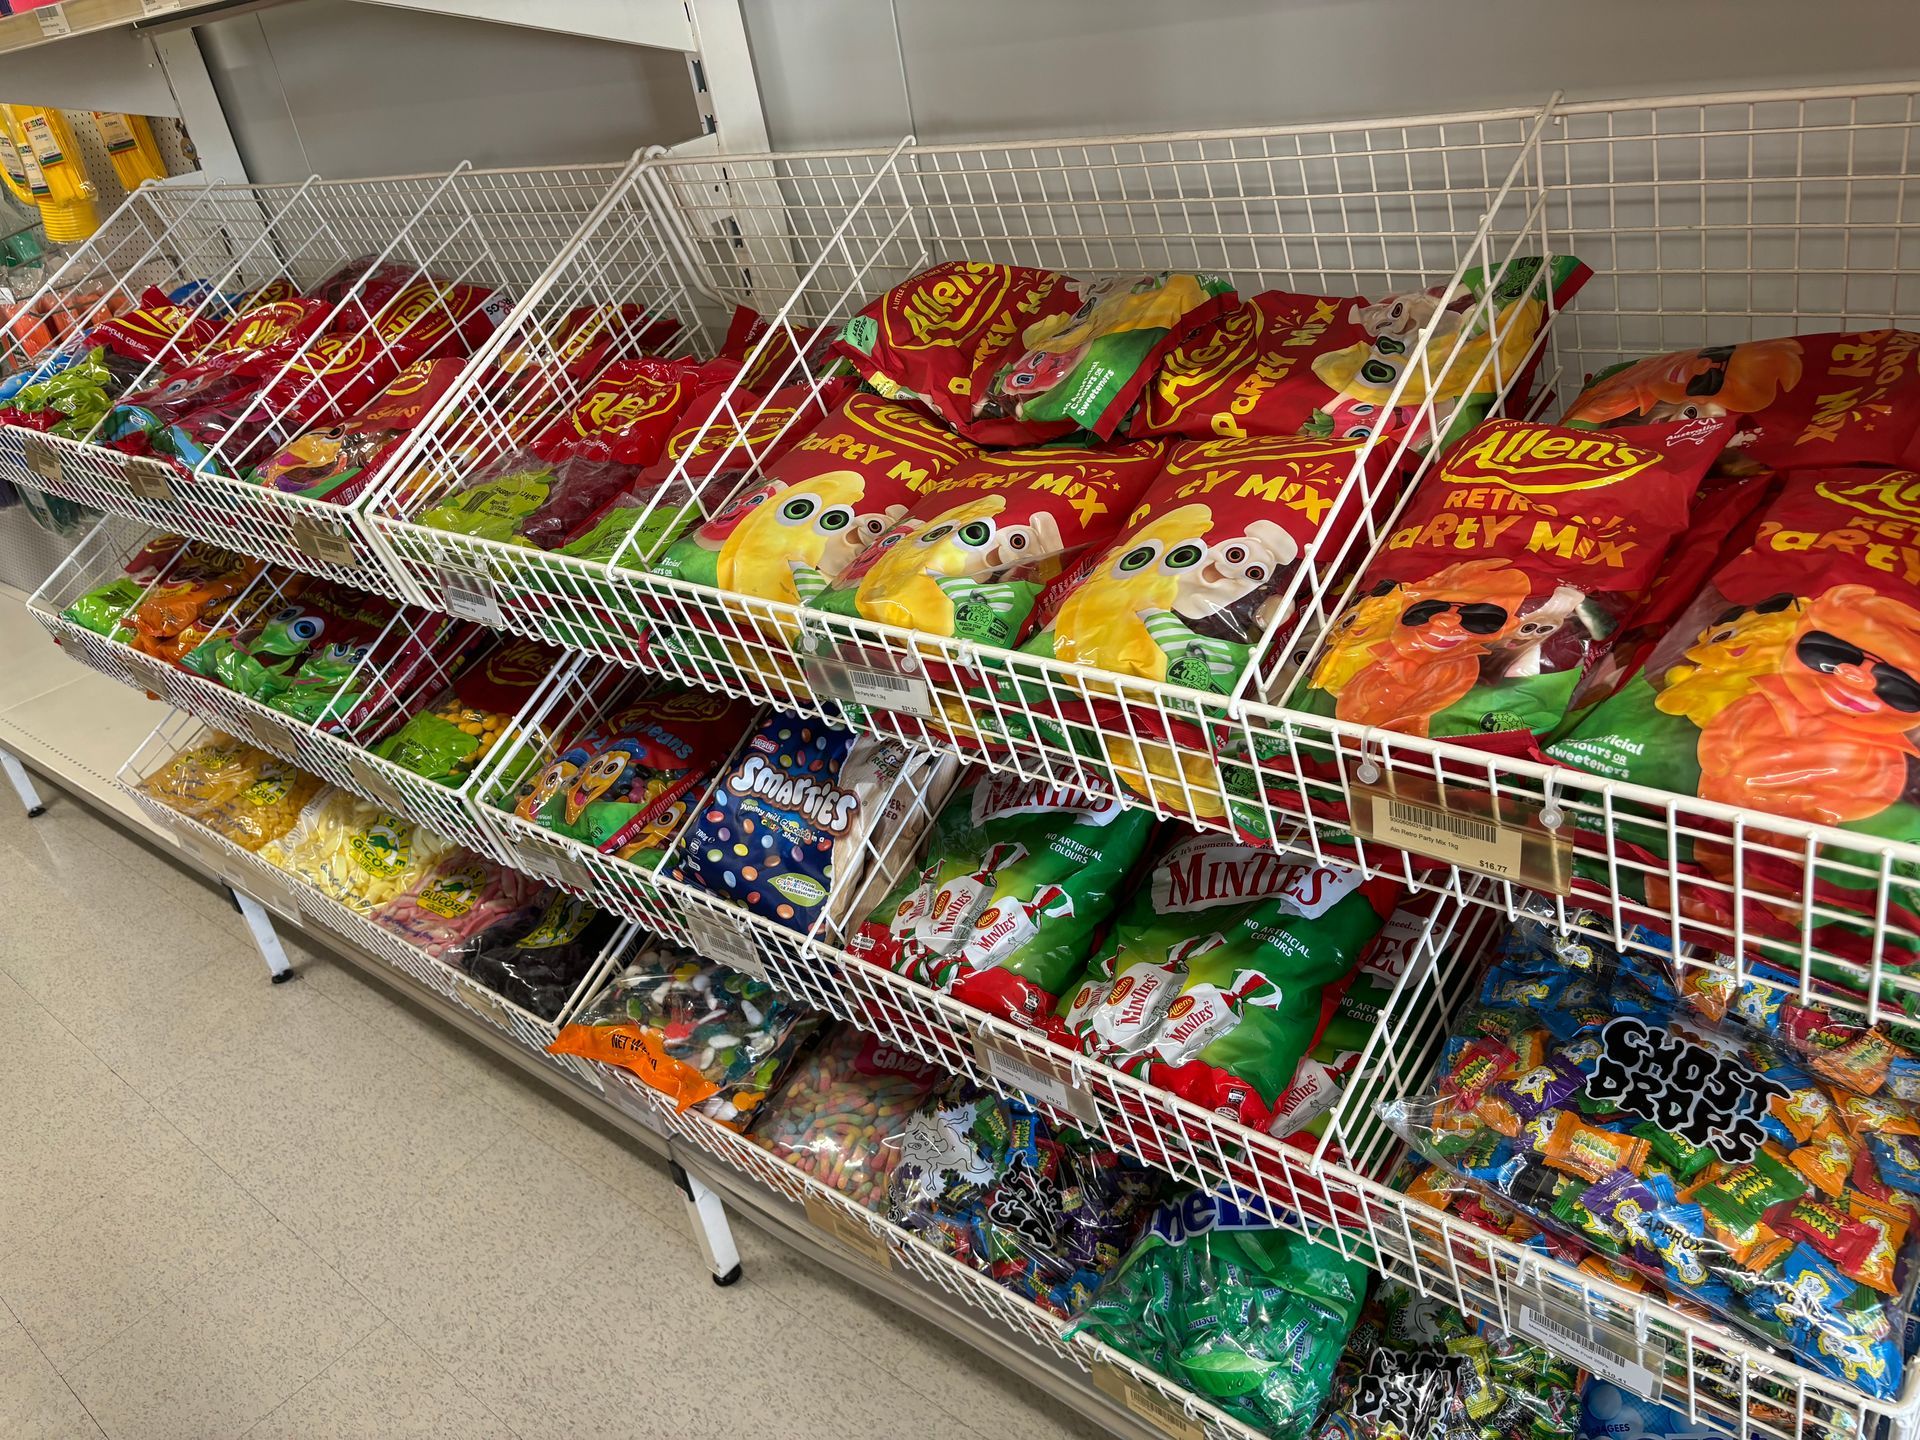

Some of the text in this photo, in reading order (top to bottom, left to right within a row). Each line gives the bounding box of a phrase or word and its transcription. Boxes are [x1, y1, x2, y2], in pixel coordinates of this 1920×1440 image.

[904, 260, 997, 343] Allen's
[852, 319, 863, 338] LESS
[1076, 368, 1116, 417] Sweeteners
[1457, 428, 1640, 468] Allen's
[966, 610, 982, 624] 1.5
[1181, 666, 1198, 681] 1.5
[1545, 744, 1631, 779] Sweeteners
[1612, 752, 1628, 765] OR
[739, 801, 766, 818] yummy
[764, 810, 782, 826] milk
[810, 830, 819, 843] in
[781, 829, 802, 845] shell
[1044, 831, 1104, 863] NO ARTIFICIAL
[1193, 841, 1235, 855] moments
[1400, 828, 1418, 839] Retro
[1417, 832, 1435, 845] Party
[1434, 837, 1448, 847] Mix
[1447, 841, 1460, 852] 1kg
[1049, 841, 1089, 866] COLOURS
[1478, 858, 1509, 874] $16.77
[420, 889, 469, 914] GLUCOSE
[1243, 917, 1311, 960] NO ARTIFICIAL
[1250, 929, 1294, 959] COLOURS
[1346, 1006, 1394, 1031] COLOUS
[611, 1033, 632, 1050] NET
[872, 1048, 935, 1079] CANDY
